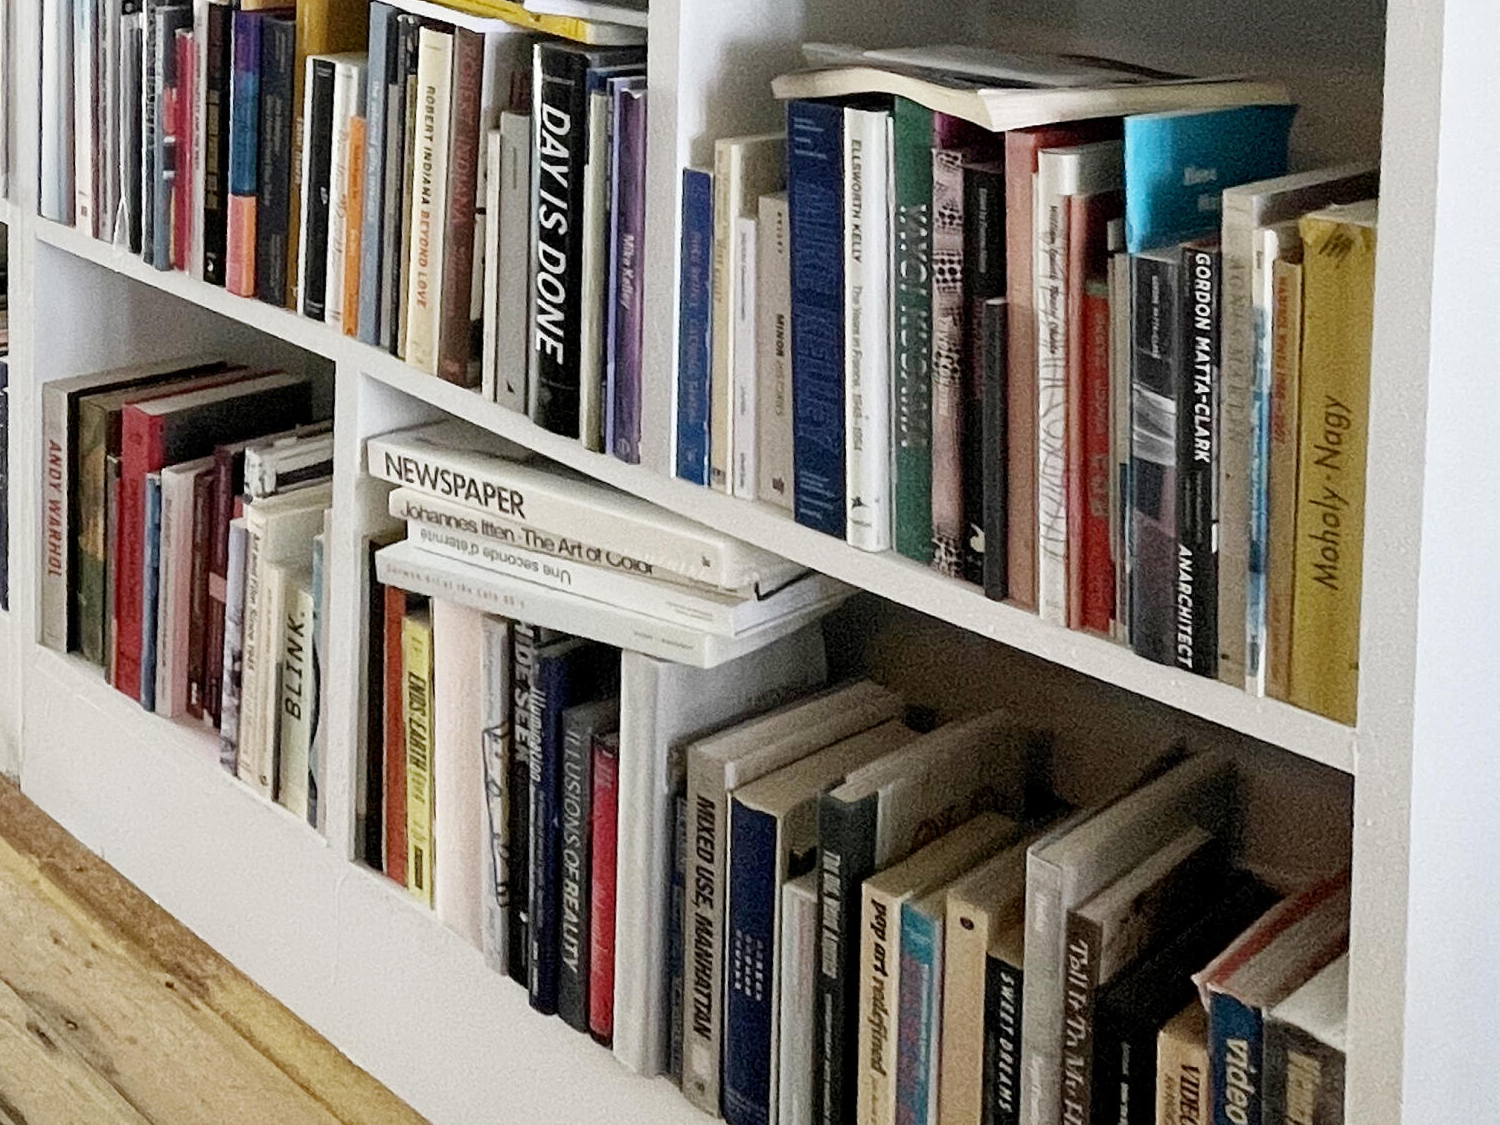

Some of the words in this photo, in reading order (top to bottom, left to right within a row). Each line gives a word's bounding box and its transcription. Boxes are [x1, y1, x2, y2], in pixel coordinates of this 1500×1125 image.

[423, 84, 437, 142] ROBERT
[541, 101, 571, 189] DAY
[420, 145, 435, 205] INDIANA
[851, 139, 862, 220] ELLSWORTH
[417, 209, 431, 267] BEYOND
[538, 188, 568, 235] IS
[851, 223, 862, 263] KELLY
[622, 233, 635, 266] Mike
[416, 270, 429, 308] LOVE
[535, 239, 567, 364] DONE
[620, 267, 634, 310] Kelley
[1194, 253, 1211, 329] GORDON
[1194, 337, 1211, 463] MATTA-CLARK
[48, 439, 62, 493] ANDY
[385, 451, 526, 519] NEWSPAPER
[47, 498, 63, 578] WARHOL
[401, 501, 478, 535] Johannes
[481, 520, 515, 543] Itten
[521, 527, 555, 552] The
[558, 539, 583, 560] Art
[586, 547, 602, 563] of
[606, 551, 653, 575] Color
[483, 545, 540, 573] seconde
[542, 563, 571, 586] Une
[1176, 544, 1193, 668] ANARCHITECT
[284, 612, 305, 721] BLINK.
[408, 672, 426, 713] ENDS
[408, 718, 427, 773] EARTH
[529, 688, 546, 783] Illumination
[562, 730, 581, 846] ILLUSIONS
[696, 795, 716, 864] MIXED
[562, 849, 580, 875] OF
[692, 865, 715, 909] USE,
[562, 878, 579, 974] REALITY
[870, 899, 887, 941] pop
[693, 912, 714, 1041] MANHATTAN
[870, 941, 887, 975] art
[867, 975, 889, 1077] redefined
[997, 971, 1015, 1032] SWEET
[996, 1037, 1014, 1113] DREAMS
[1225, 1038, 1256, 1124] video
